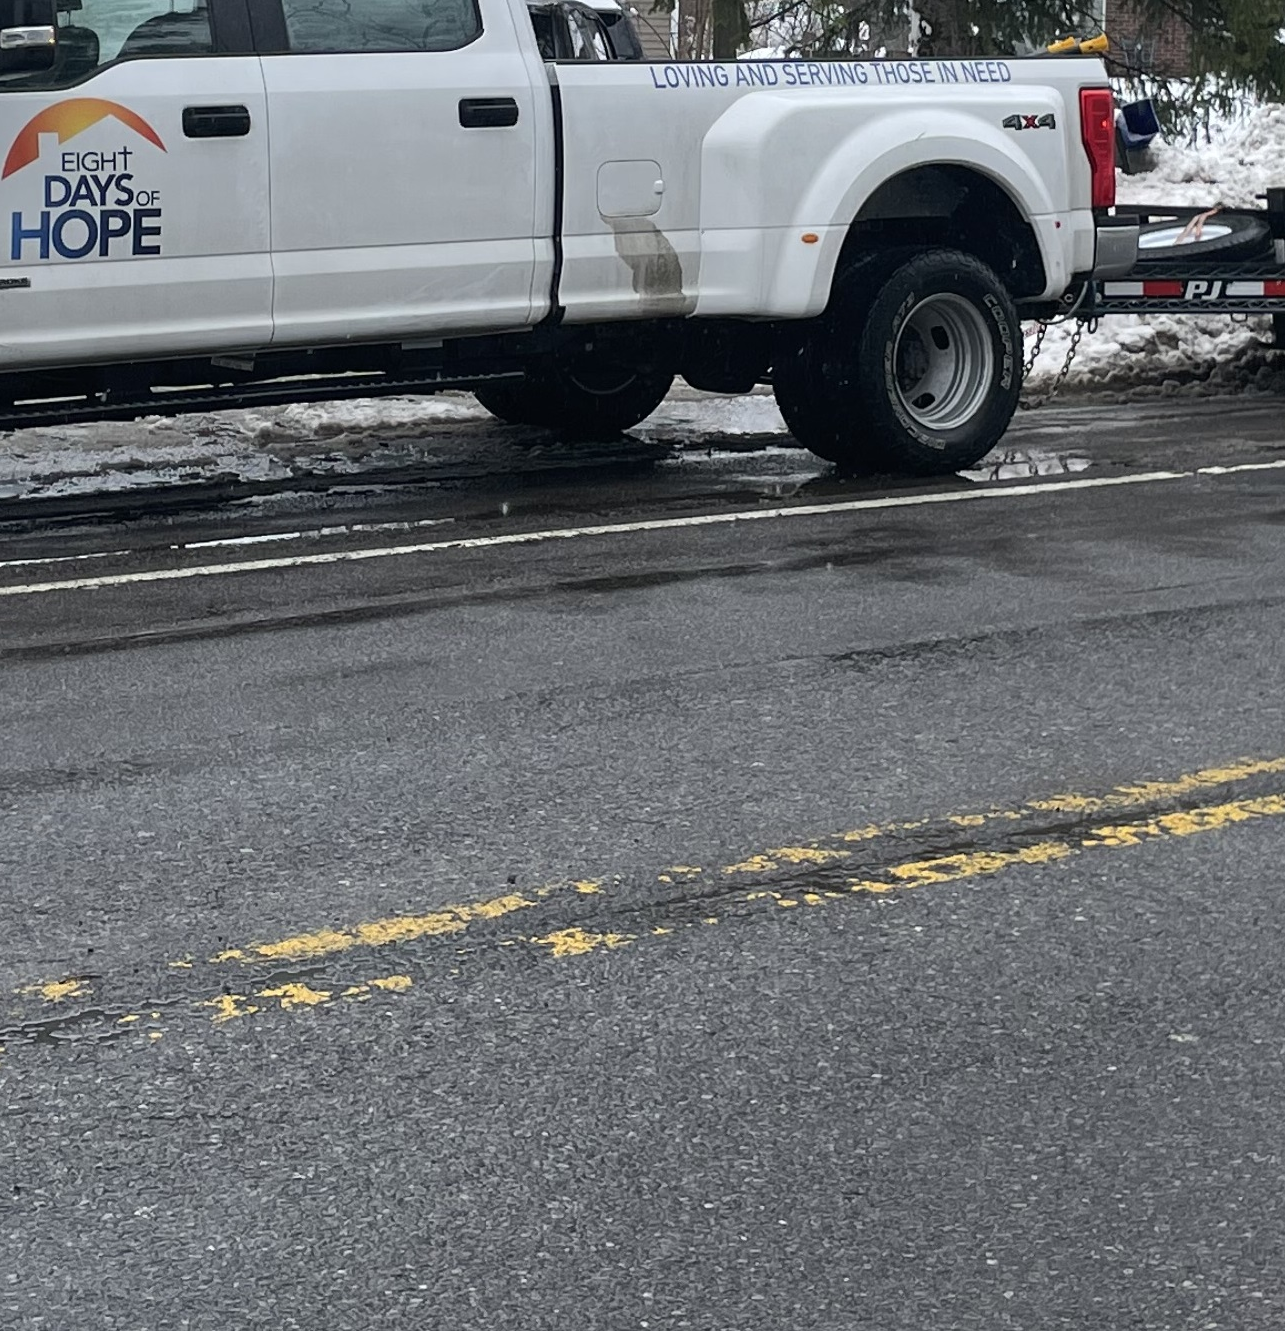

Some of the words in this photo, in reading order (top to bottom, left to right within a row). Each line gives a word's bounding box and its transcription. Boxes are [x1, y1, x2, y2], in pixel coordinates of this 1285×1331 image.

[650, 64, 729, 88] LOVING
[735, 64, 779, 87] AND
[782, 63, 867, 86] SERVING
[869, 61, 936, 85] THOSE
[935, 61, 959, 83] IN
[959, 60, 1012, 83] NEED
[61, 146, 133, 172] EIGHT
[44, 173, 134, 208] DAYS
[135, 190, 161, 207] OF
[10, 208, 162, 260] HOPE
[1184, 280, 1222, 300] PJ
[982, 292, 1014, 391] COOPER
